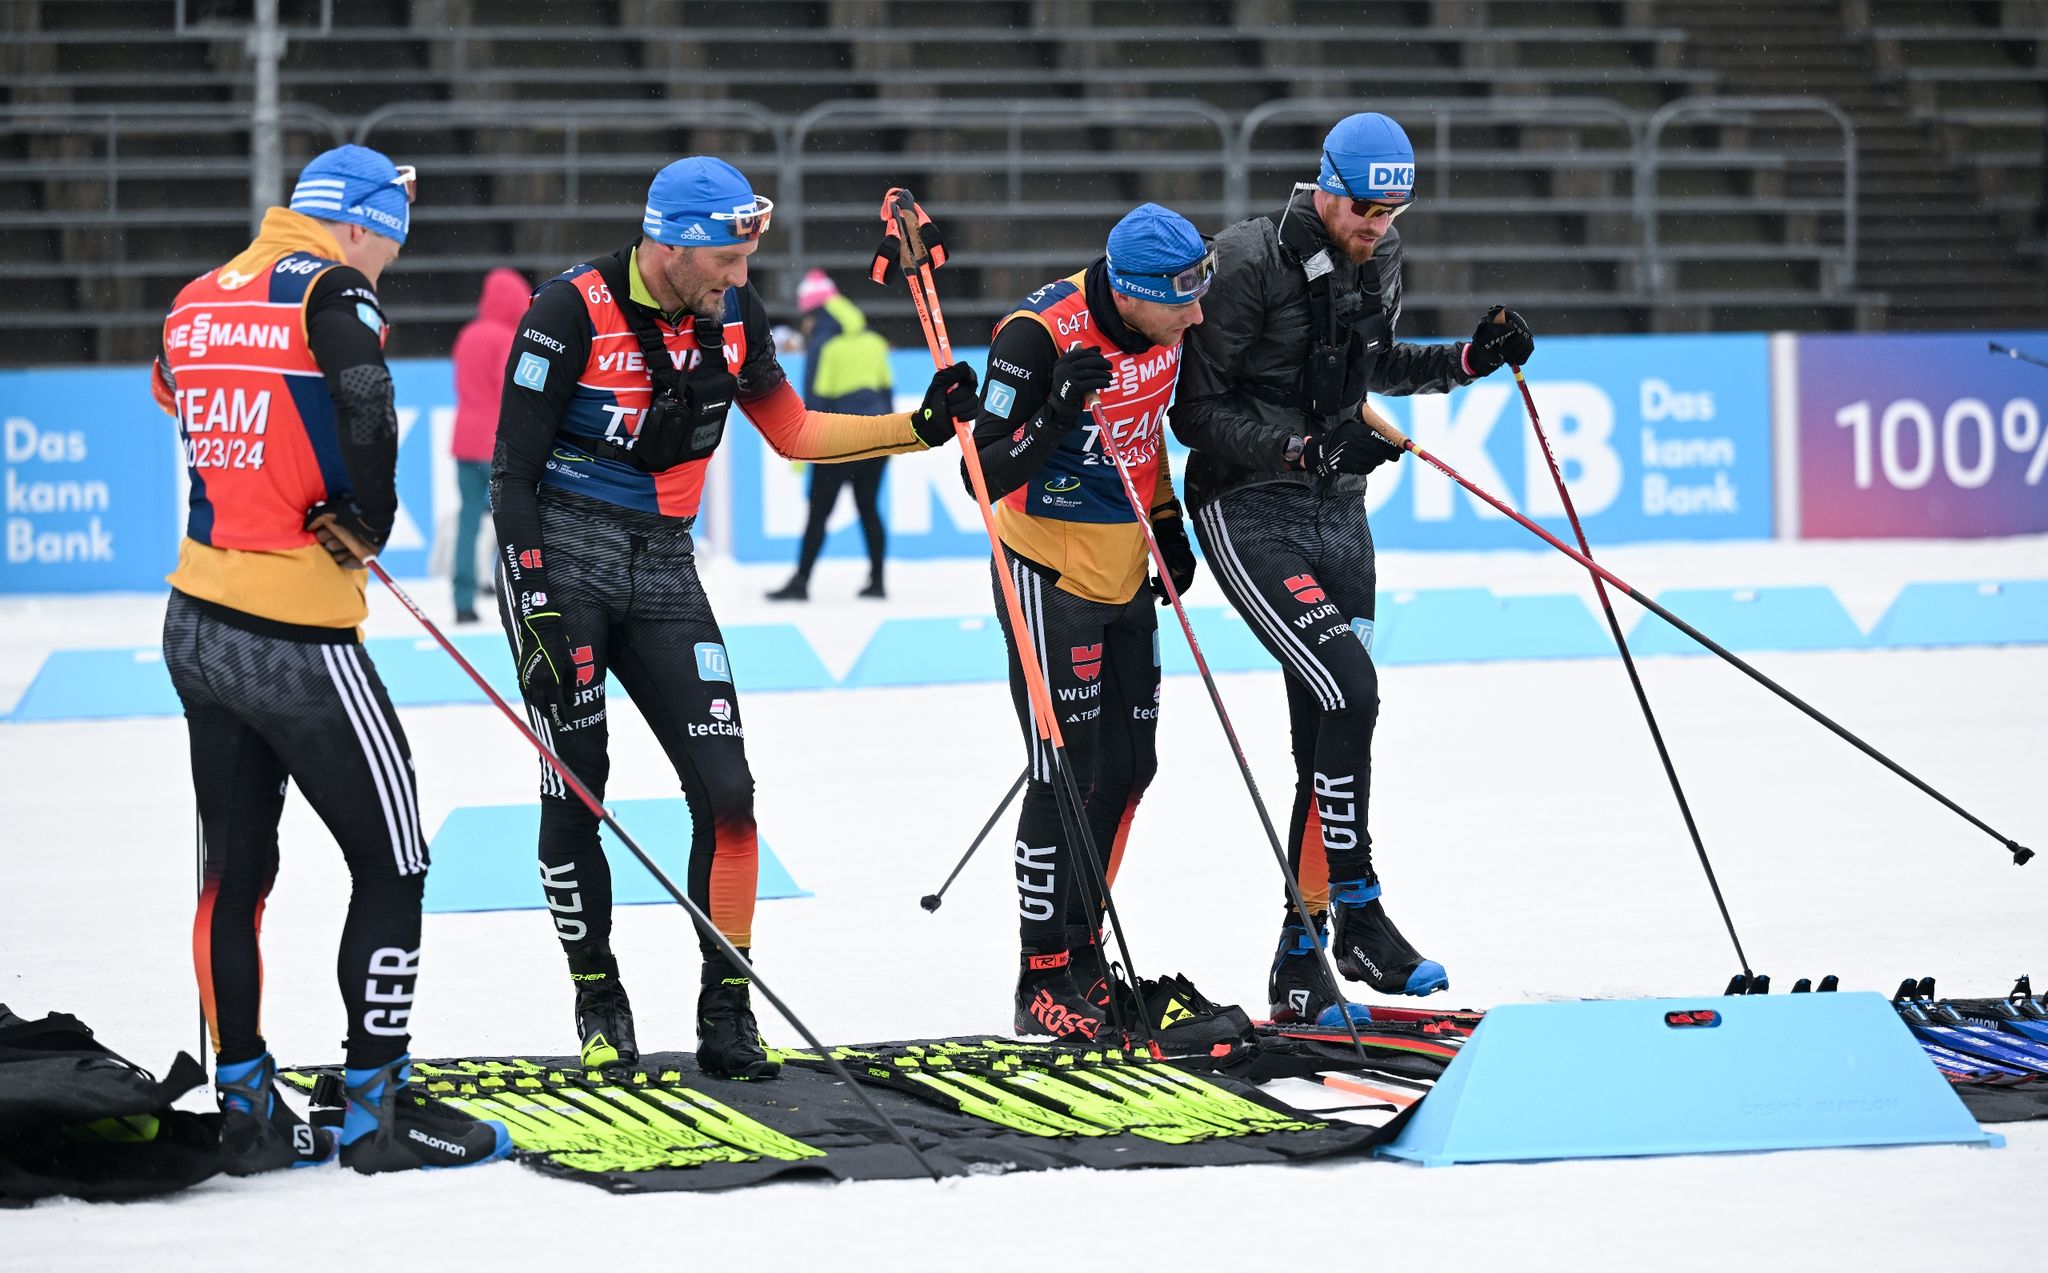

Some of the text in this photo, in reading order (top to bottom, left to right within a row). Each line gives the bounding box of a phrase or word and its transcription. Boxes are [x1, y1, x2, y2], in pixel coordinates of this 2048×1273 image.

[680, 233, 711, 241] adidas
[275, 257, 322, 275] 648
[1125, 281, 1167, 299] TERREX
[530, 329, 567, 354] TERREX
[1057, 310, 1090, 336] 647
[1640, 377, 1715, 422] Das
[5, 416, 88, 463] Das
[184, 437, 264, 471] 023/24
[1641, 426, 1736, 468] kann
[6, 467, 109, 514] kann
[1641, 471, 1739, 515] Bank
[7, 515, 115, 564] Bank
[506, 543, 521, 581] WÜRTH
[1313, 771, 1358, 851] GER
[538, 860, 588, 942] GER
[1014, 839, 1057, 921] GER
[1353, 945, 1384, 981] salomon
[364, 947, 421, 1036] GER
[409, 1128, 466, 1157] salomon
